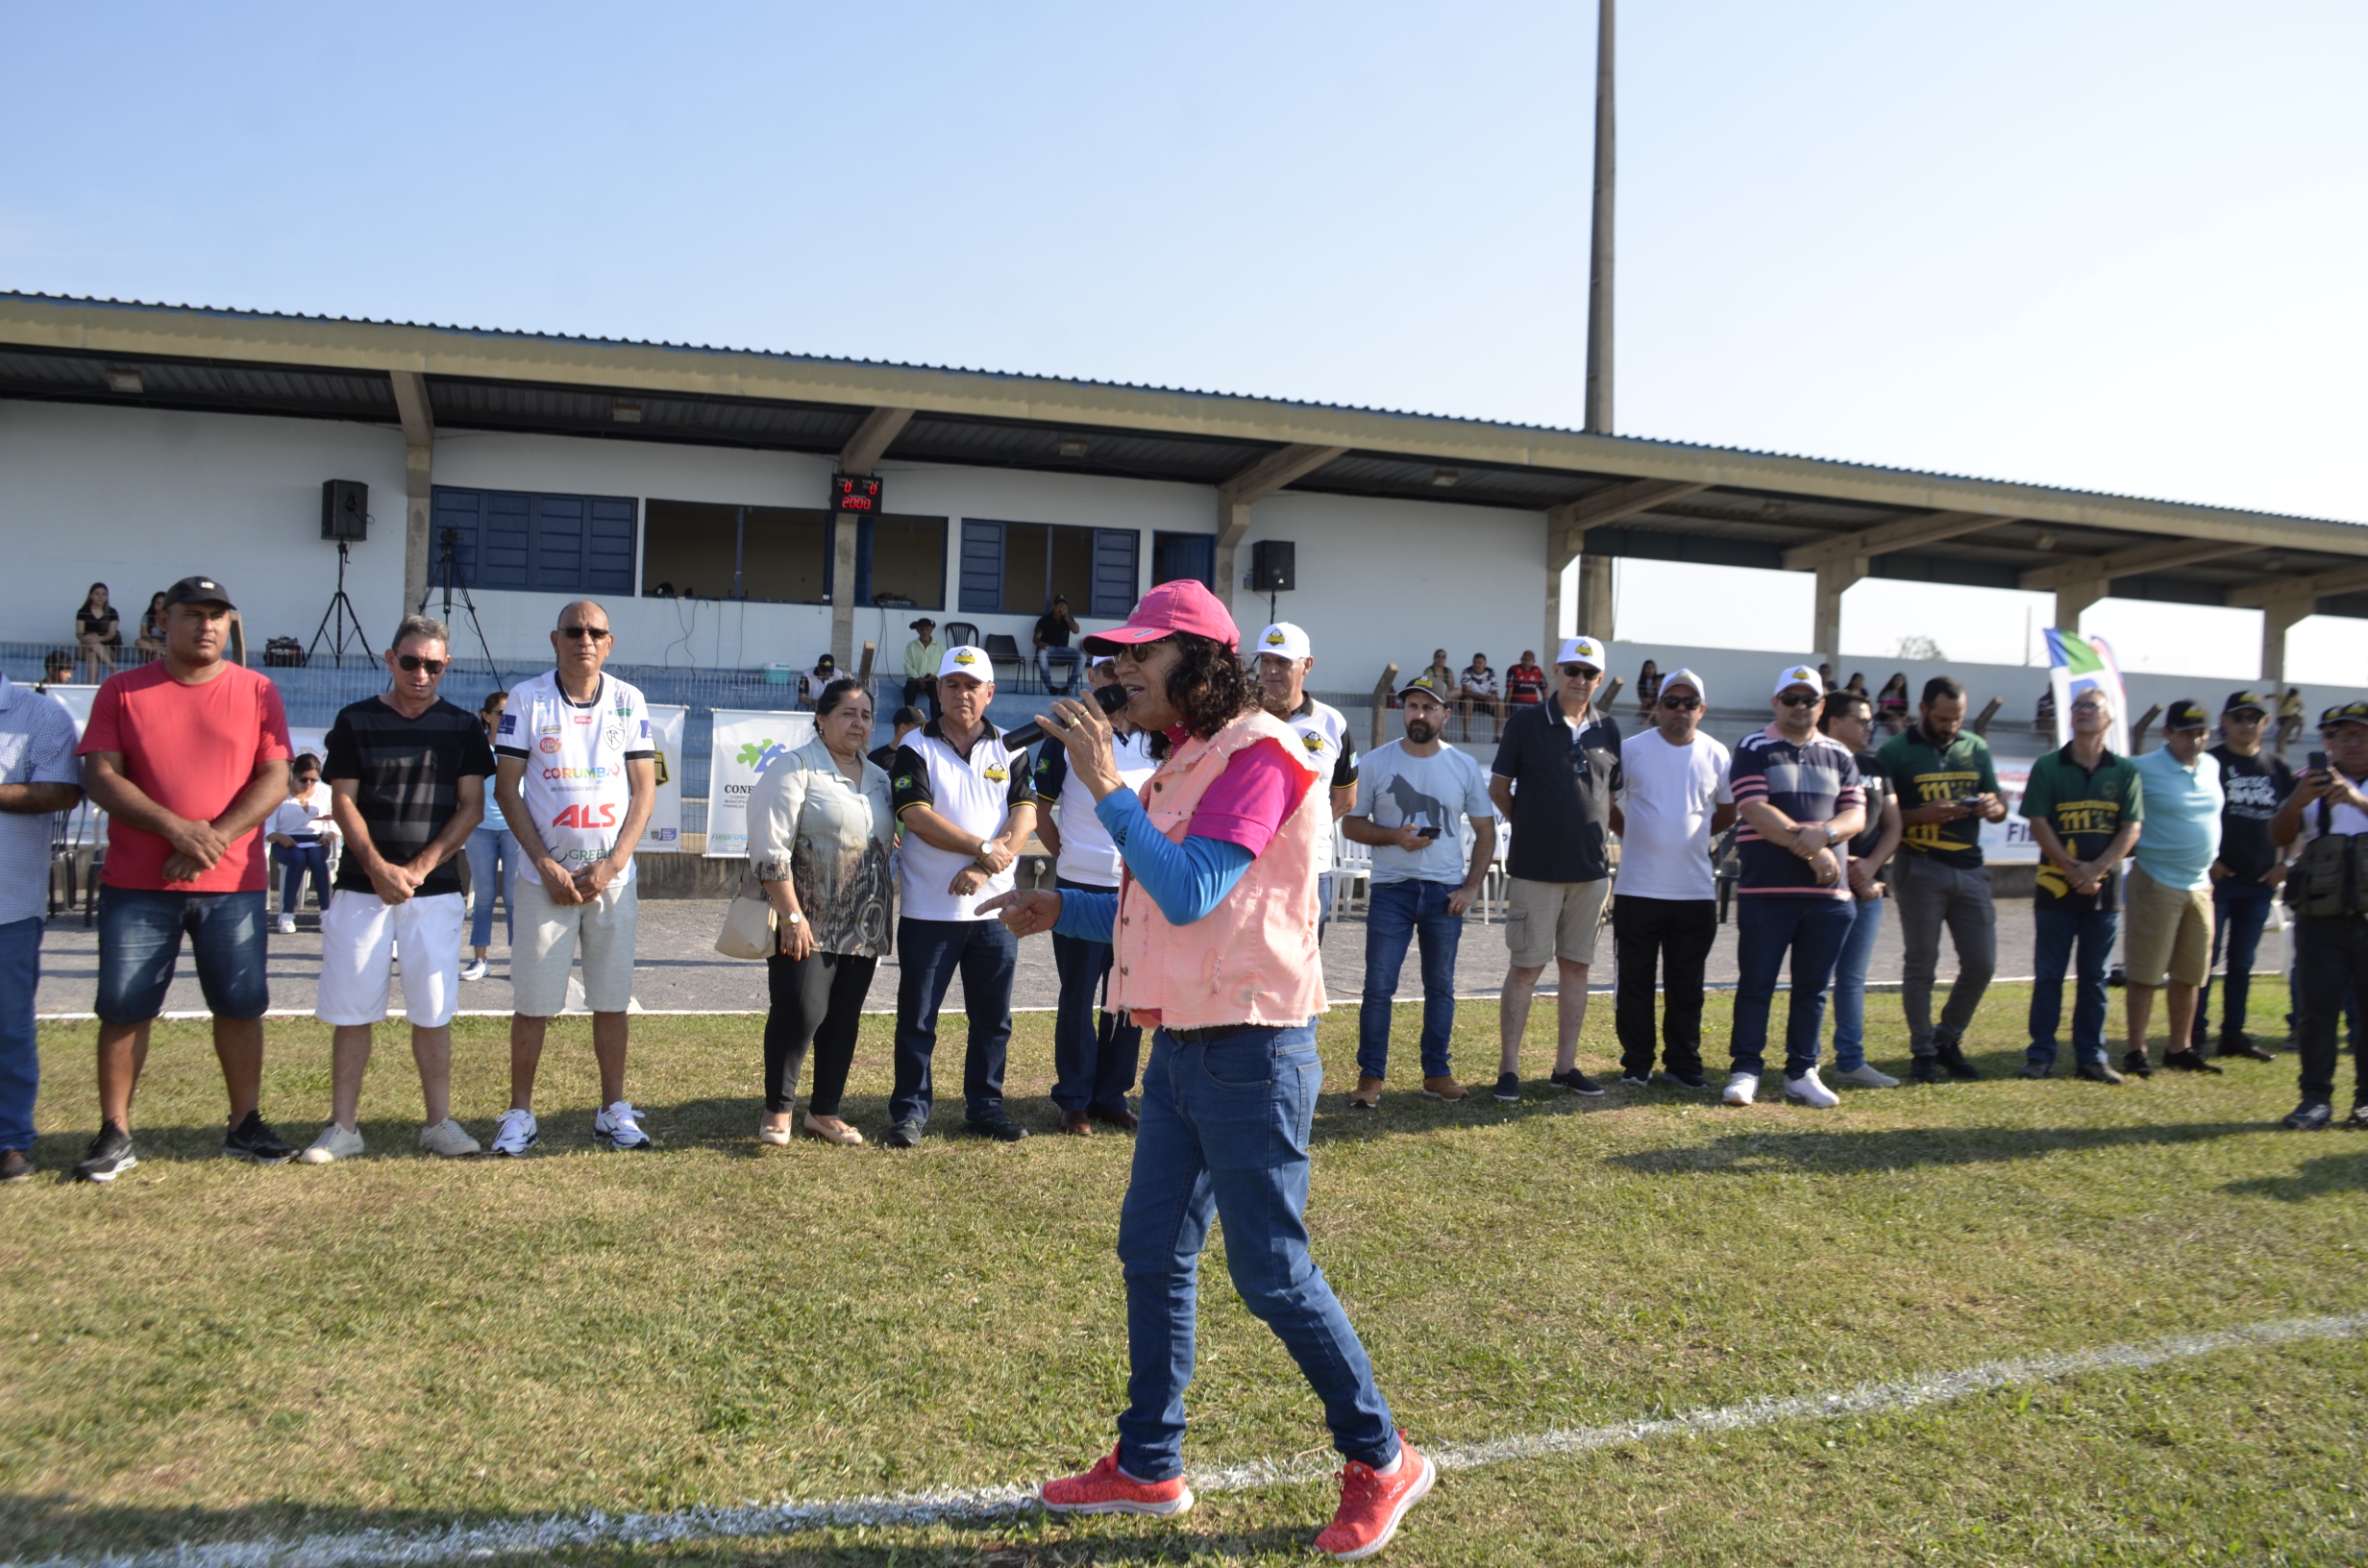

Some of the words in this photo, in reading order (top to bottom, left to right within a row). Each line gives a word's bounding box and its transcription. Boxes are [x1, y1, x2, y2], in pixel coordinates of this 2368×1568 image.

[844, 481, 852, 493] 0
[870, 483, 878, 495] 0
[724, 784, 755, 795] CONF
[553, 803, 617, 829] ALS
